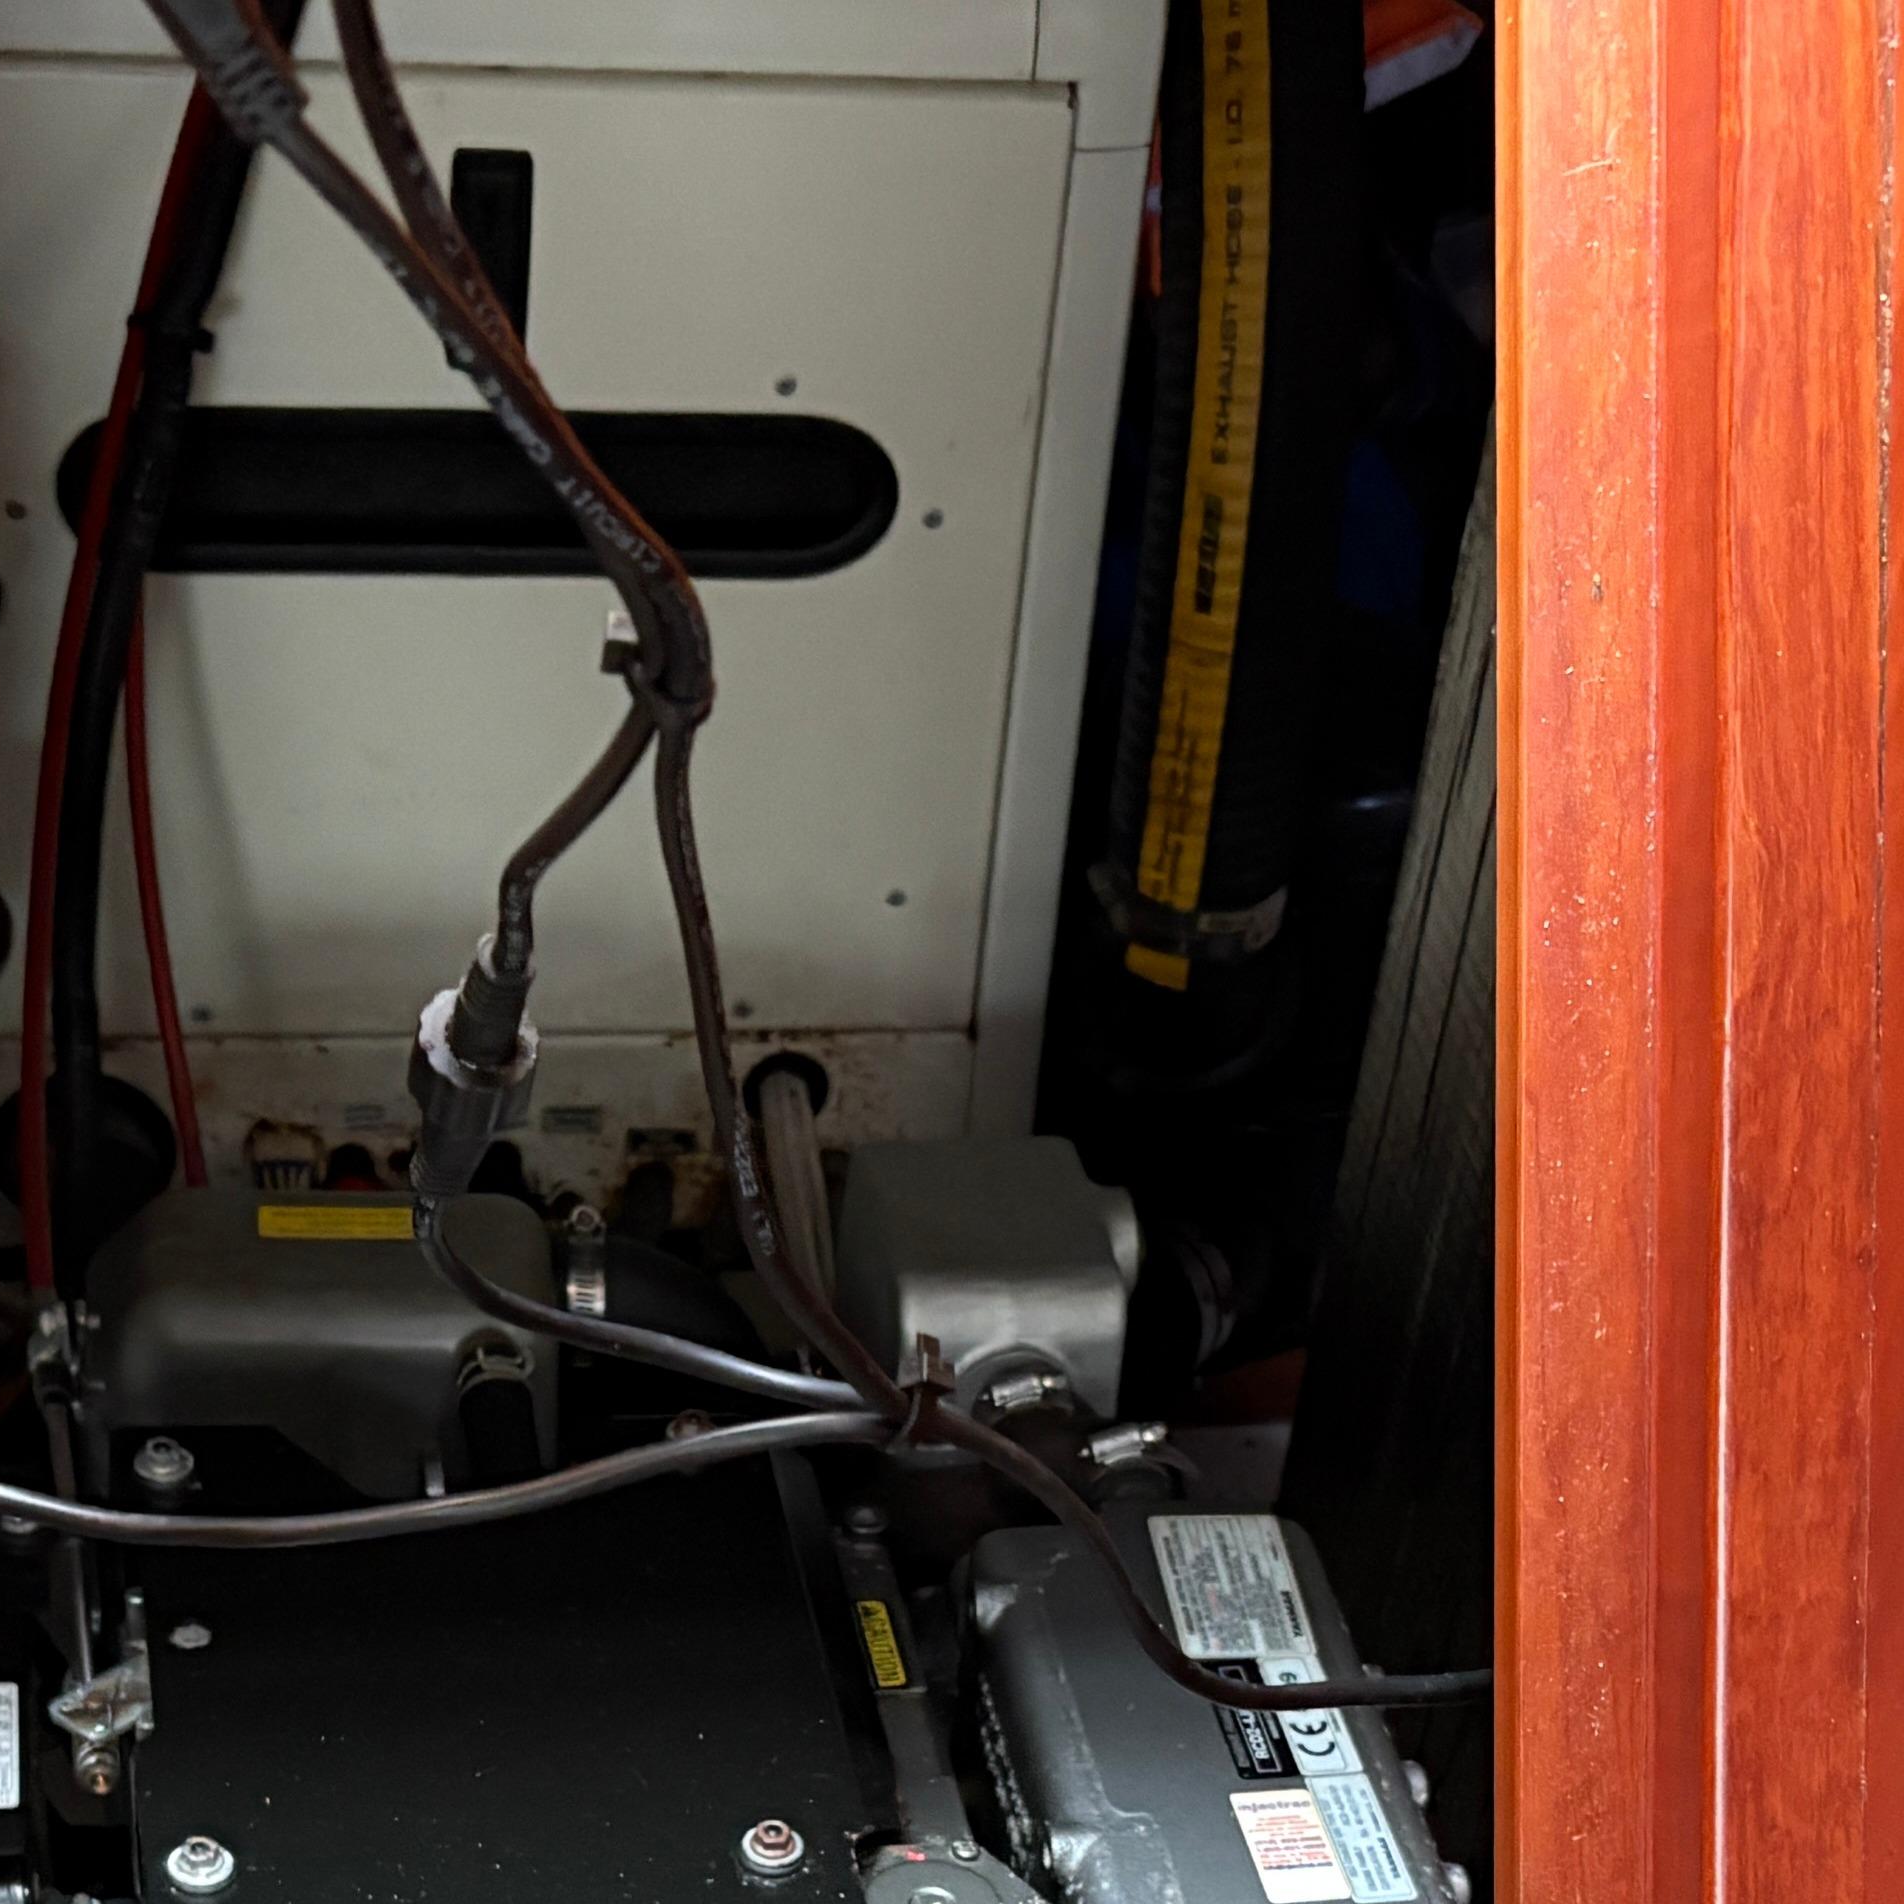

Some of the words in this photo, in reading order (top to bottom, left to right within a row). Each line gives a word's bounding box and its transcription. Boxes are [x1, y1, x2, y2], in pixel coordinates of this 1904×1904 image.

[1223, 184, 1243, 284] HOSE
[1211, 298, 1239, 465] EXHAUST
[864, 1618, 899, 1681] CAUTION
[1288, 1722, 1335, 1756] CE
